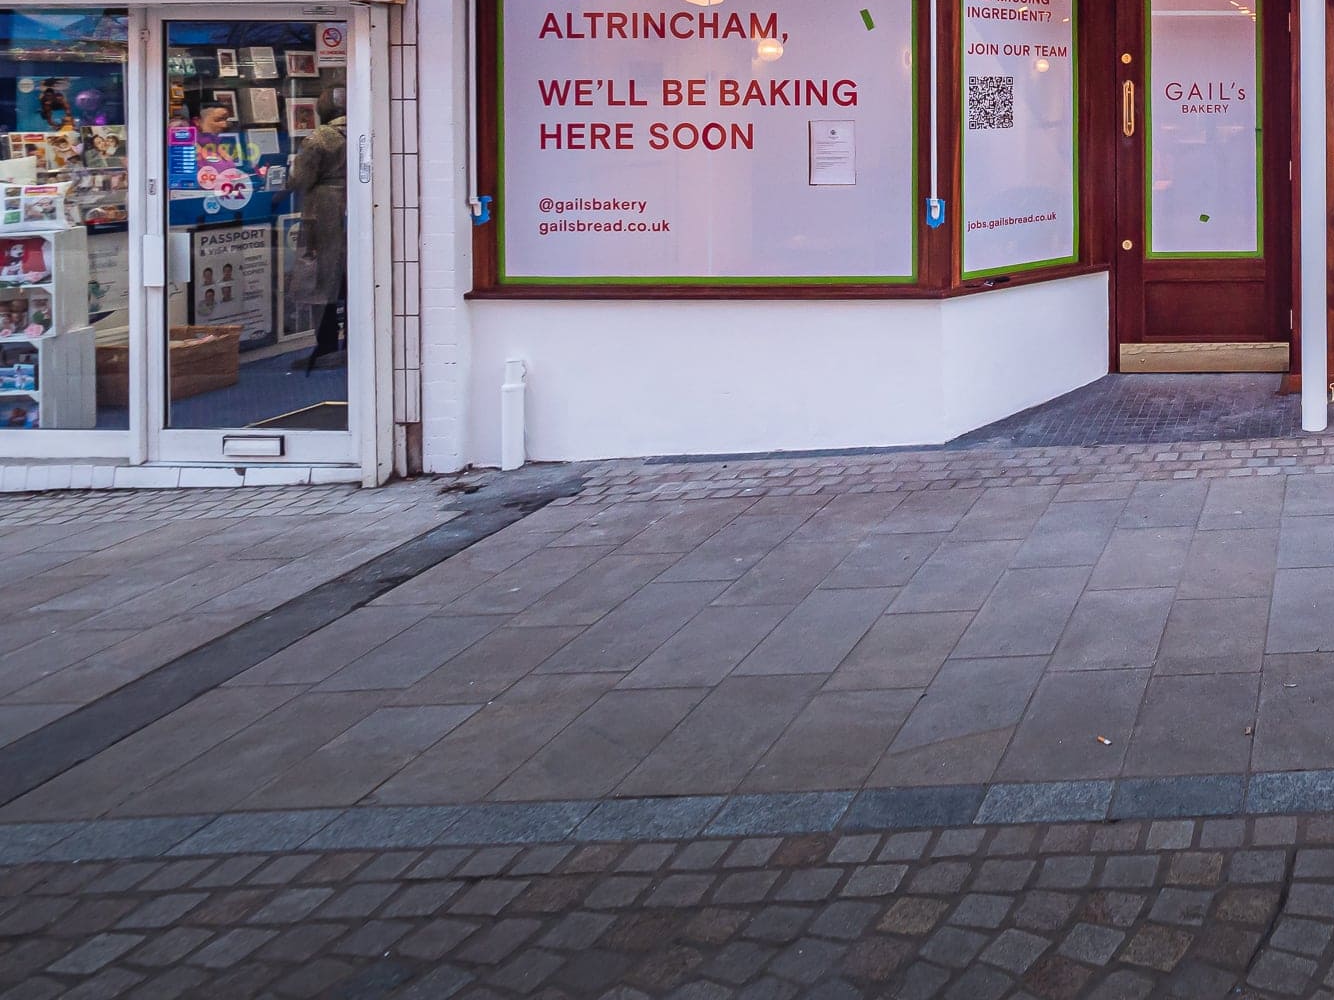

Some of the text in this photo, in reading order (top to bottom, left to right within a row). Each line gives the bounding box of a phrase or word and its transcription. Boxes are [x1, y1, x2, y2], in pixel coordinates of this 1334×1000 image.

[967, 6, 1052, 23] INGREDIENT?
[538, 12, 789, 44] ALTRINCHAM,
[967, 43, 1067, 57] JOIN OUR TEAM
[662, 79, 706, 106] BE
[719, 79, 858, 107] BAKING
[1165, 80, 1246, 101] GAIL's
[1181, 104, 1229, 114] BAKERY
[540, 122, 754, 151] HERE SOON
[538, 198, 647, 213] @gailsbakery
[538, 219, 671, 235] gailsbread.co.uk
[967, 211, 1057, 232] jobs.gailsbread.co.uk
[200, 229, 266, 246] PASSPORT
